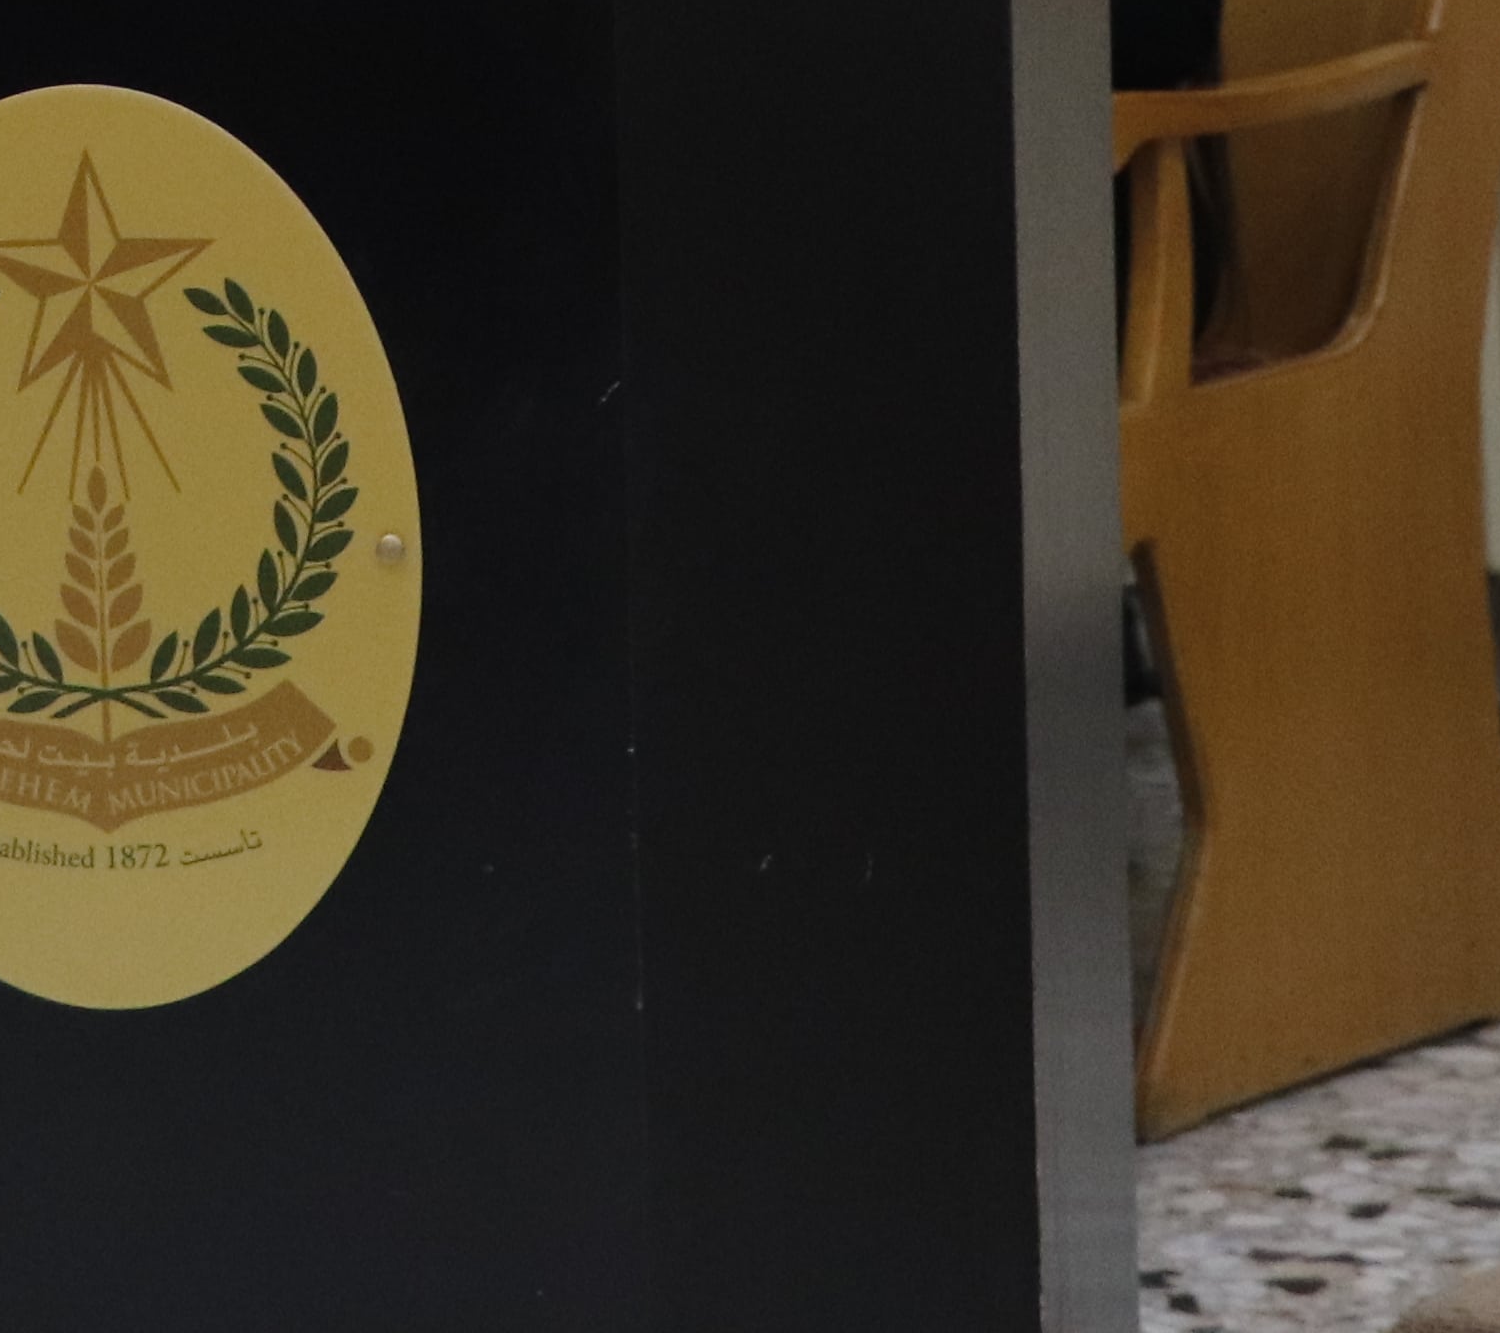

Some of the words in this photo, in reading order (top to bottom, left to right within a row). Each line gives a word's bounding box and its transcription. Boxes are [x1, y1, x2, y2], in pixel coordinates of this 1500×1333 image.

[38, 745, 115, 777] بيت
[126, 722, 258, 773] بلدية
[108, 730, 301, 815] MUNICIPALITY
[107, 843, 169, 869] 1872
